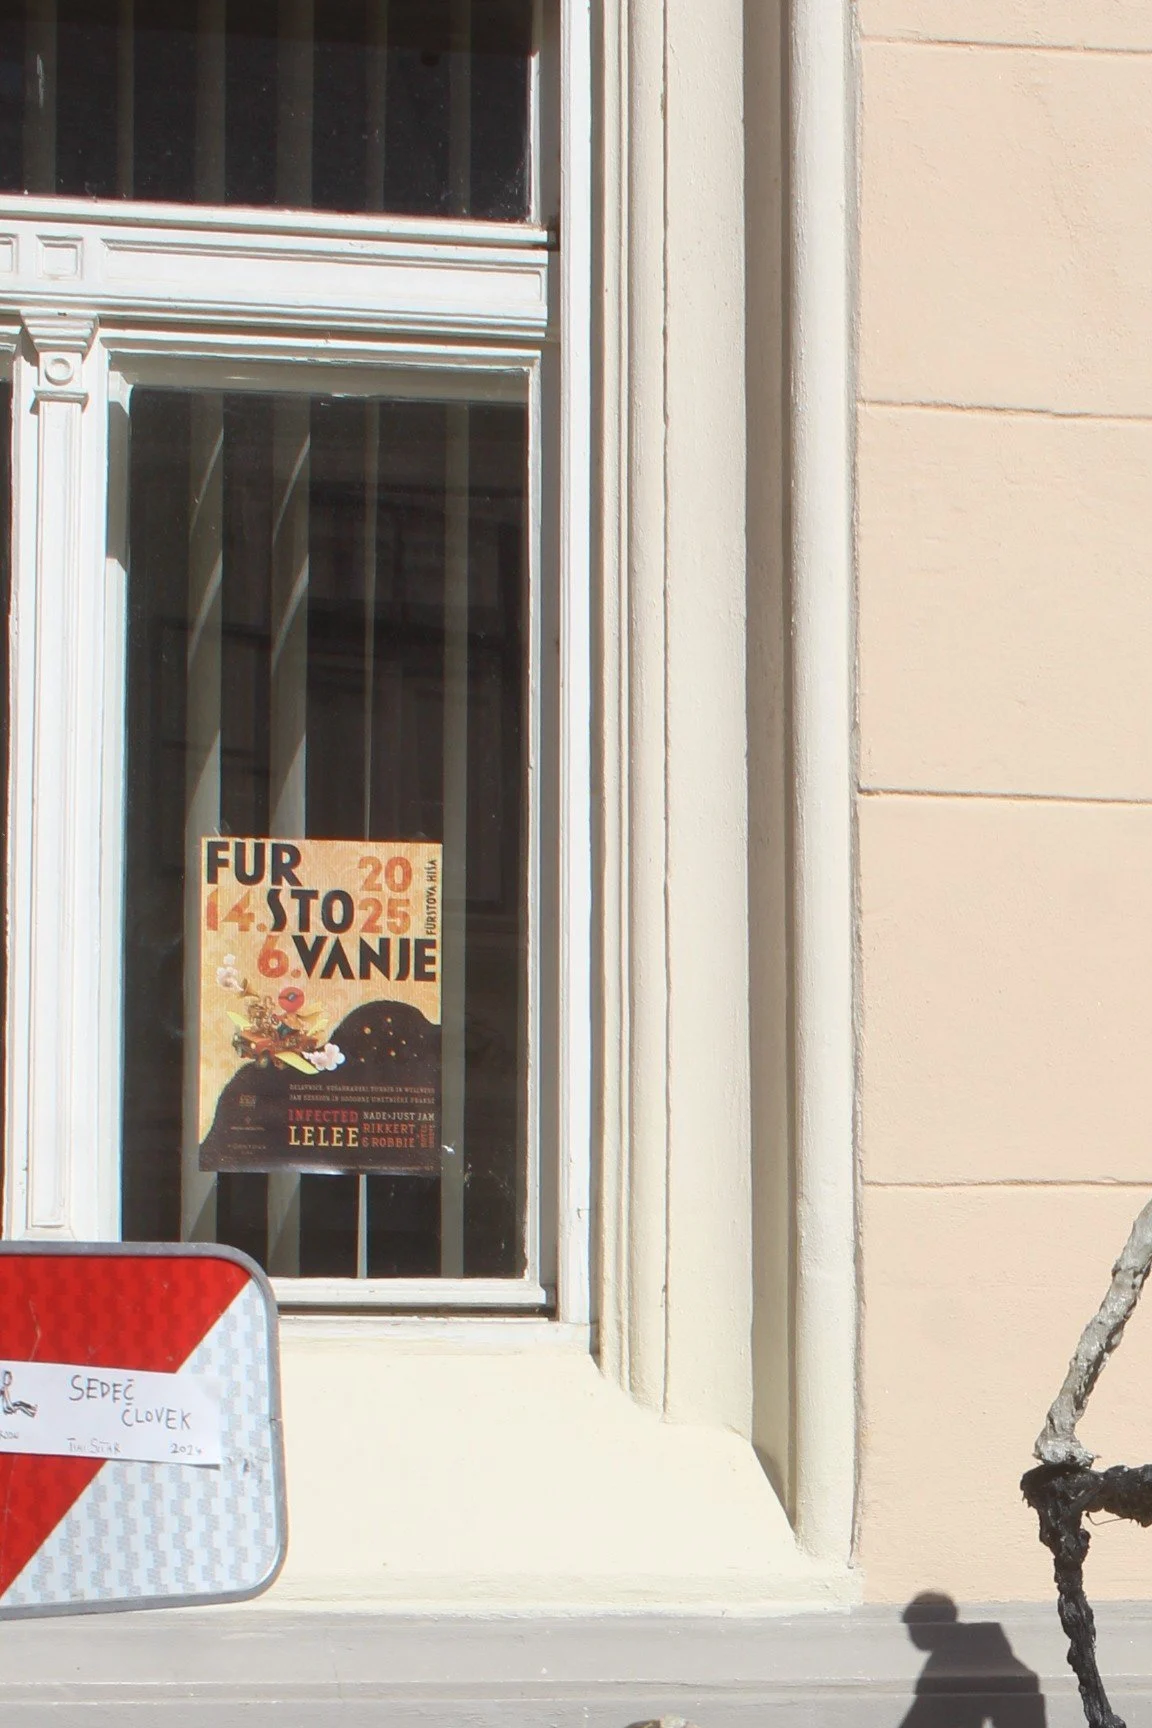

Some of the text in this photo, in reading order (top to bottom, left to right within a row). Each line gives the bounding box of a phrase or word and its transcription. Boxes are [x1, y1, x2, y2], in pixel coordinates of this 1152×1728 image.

[207, 841, 302, 886] FUR
[358, 856, 412, 893] 20
[206, 888, 267, 933] 14.
[267, 889, 354, 934] STO
[358, 898, 411, 935] 25
[257, 935, 302, 979] 6.
[292, 936, 437, 982] VANJE
[288, 1109, 358, 1122] INFECTED
[363, 1123, 415, 1134] RIKKERT
[418, 1112, 435, 1121] JAM
[289, 1126, 359, 1147] LELEE
[372, 1137, 416, 1148] ROBBIE
[68, 1374, 134, 1402] SEDEČ
[121, 1402, 192, 1430] ČLOVEK
